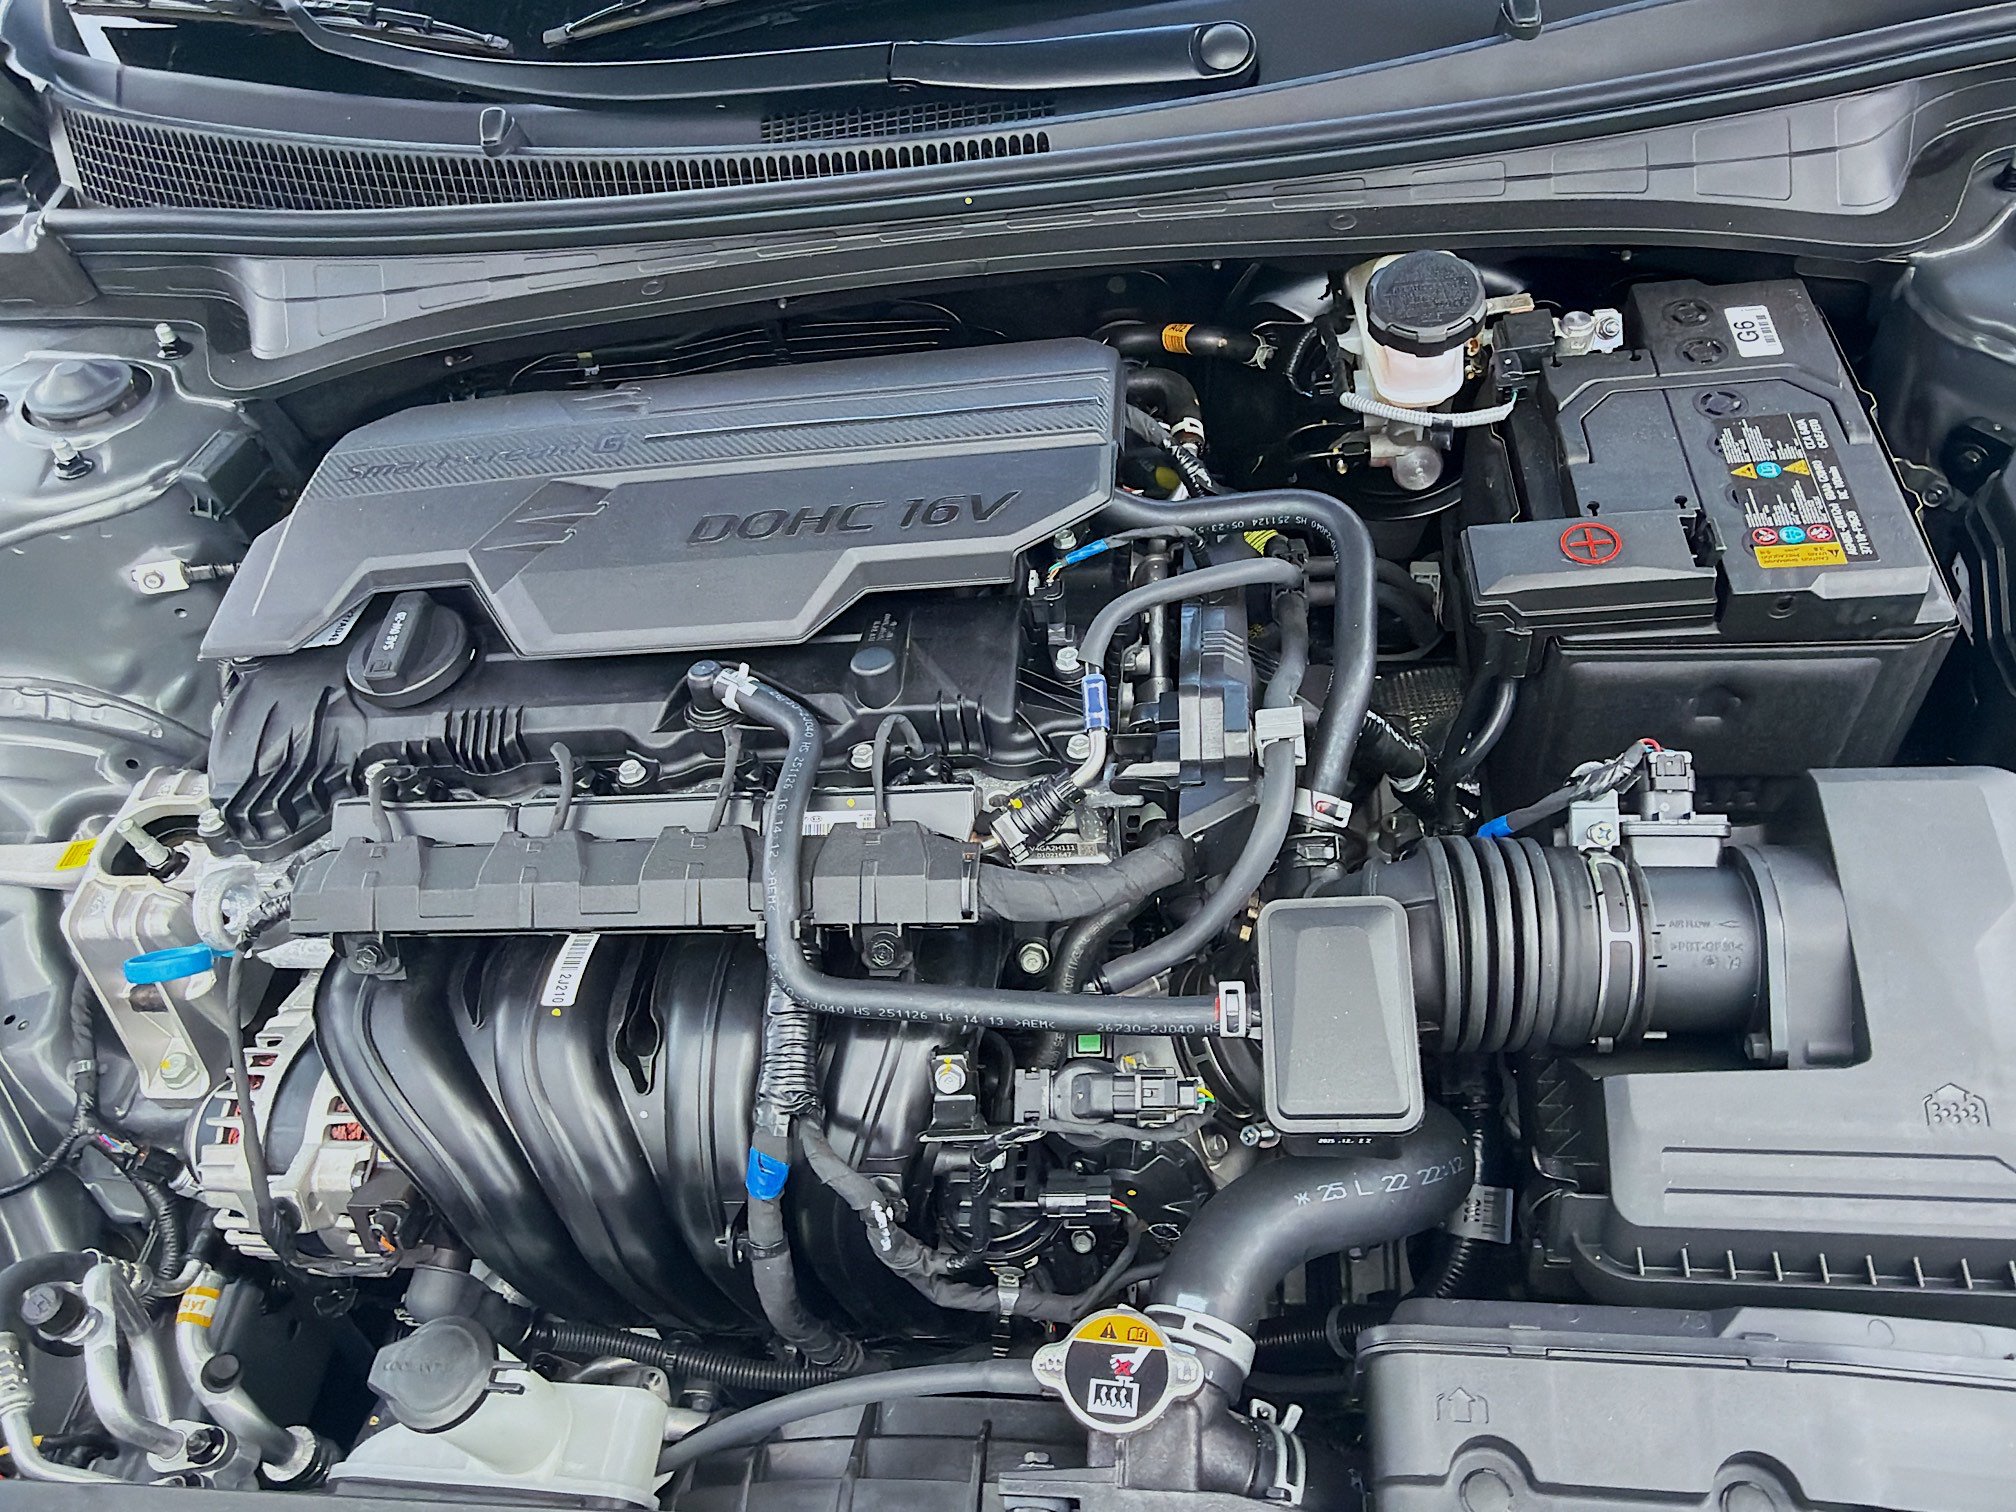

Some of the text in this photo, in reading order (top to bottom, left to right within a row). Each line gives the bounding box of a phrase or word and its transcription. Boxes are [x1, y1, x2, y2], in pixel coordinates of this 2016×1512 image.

[1733, 320, 1760, 342] G6
[594, 431, 631, 454] G
[686, 489, 1024, 547] DOHC 16V
[1252, 515, 1290, 528] 251124
[1295, 515, 1308, 525] HS
[382, 634, 399, 651] SAE
[798, 741, 812, 753] HS
[783, 756, 805, 790] 251126
[552, 973, 572, 1003] 2J210
[768, 953, 846, 1015] 26730-2J040
[853, 1006, 871, 1016] HS
[878, 1008, 929, 1021] 251126
[1096, 1022, 1196, 1035] 26730-2J040
[1317, 1182, 1348, 1202] 25
[1381, 1173, 1412, 1193] 22
